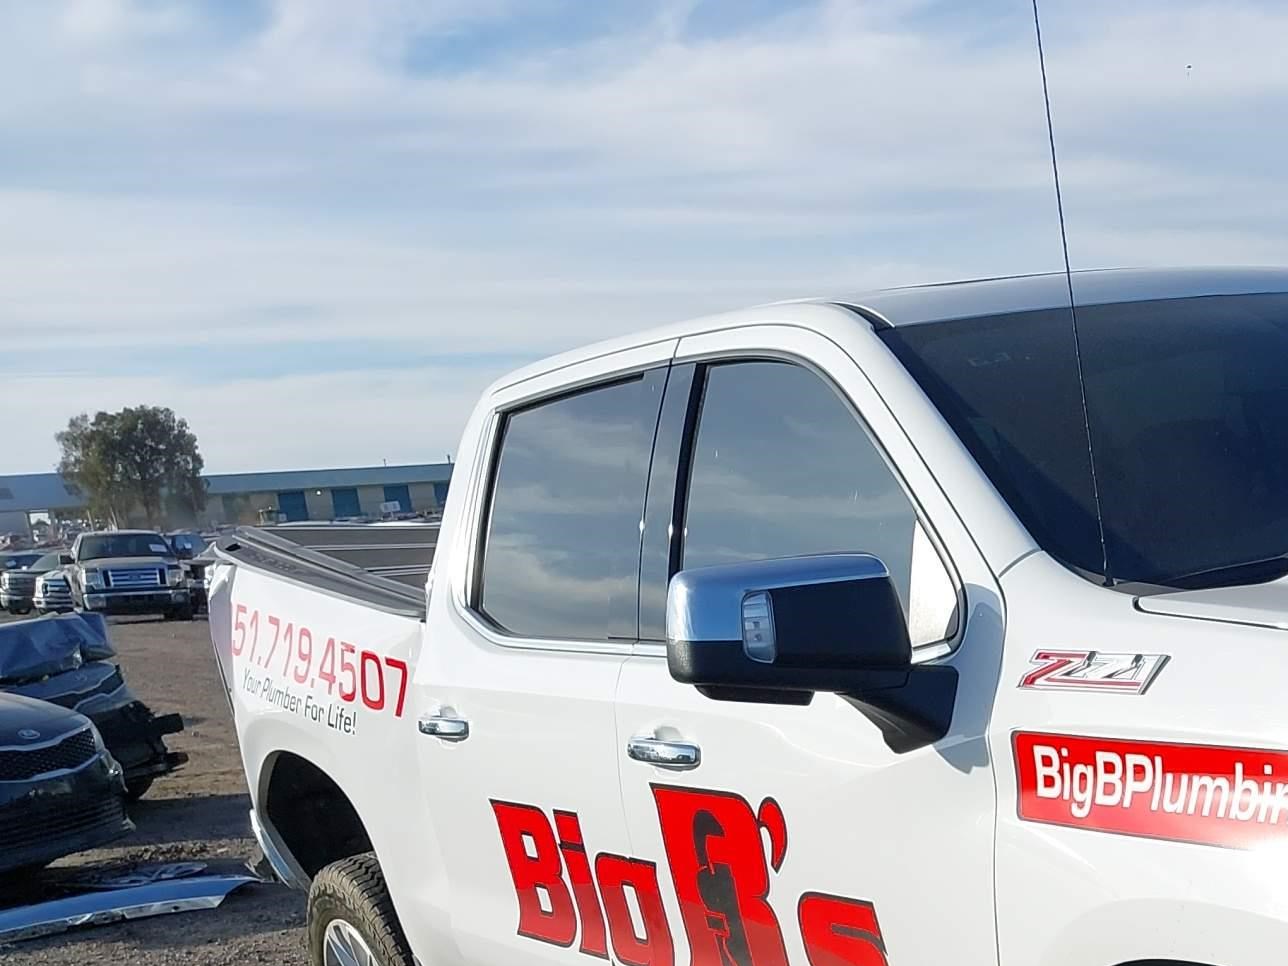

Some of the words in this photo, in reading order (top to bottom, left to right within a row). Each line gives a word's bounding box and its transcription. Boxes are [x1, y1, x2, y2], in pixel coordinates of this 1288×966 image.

[1017, 649, 1172, 695] Z71
[242, 667, 262, 694] Your
[262, 677, 301, 713] Plumber
[305, 696, 324, 722] For
[327, 704, 356, 735] Life!
